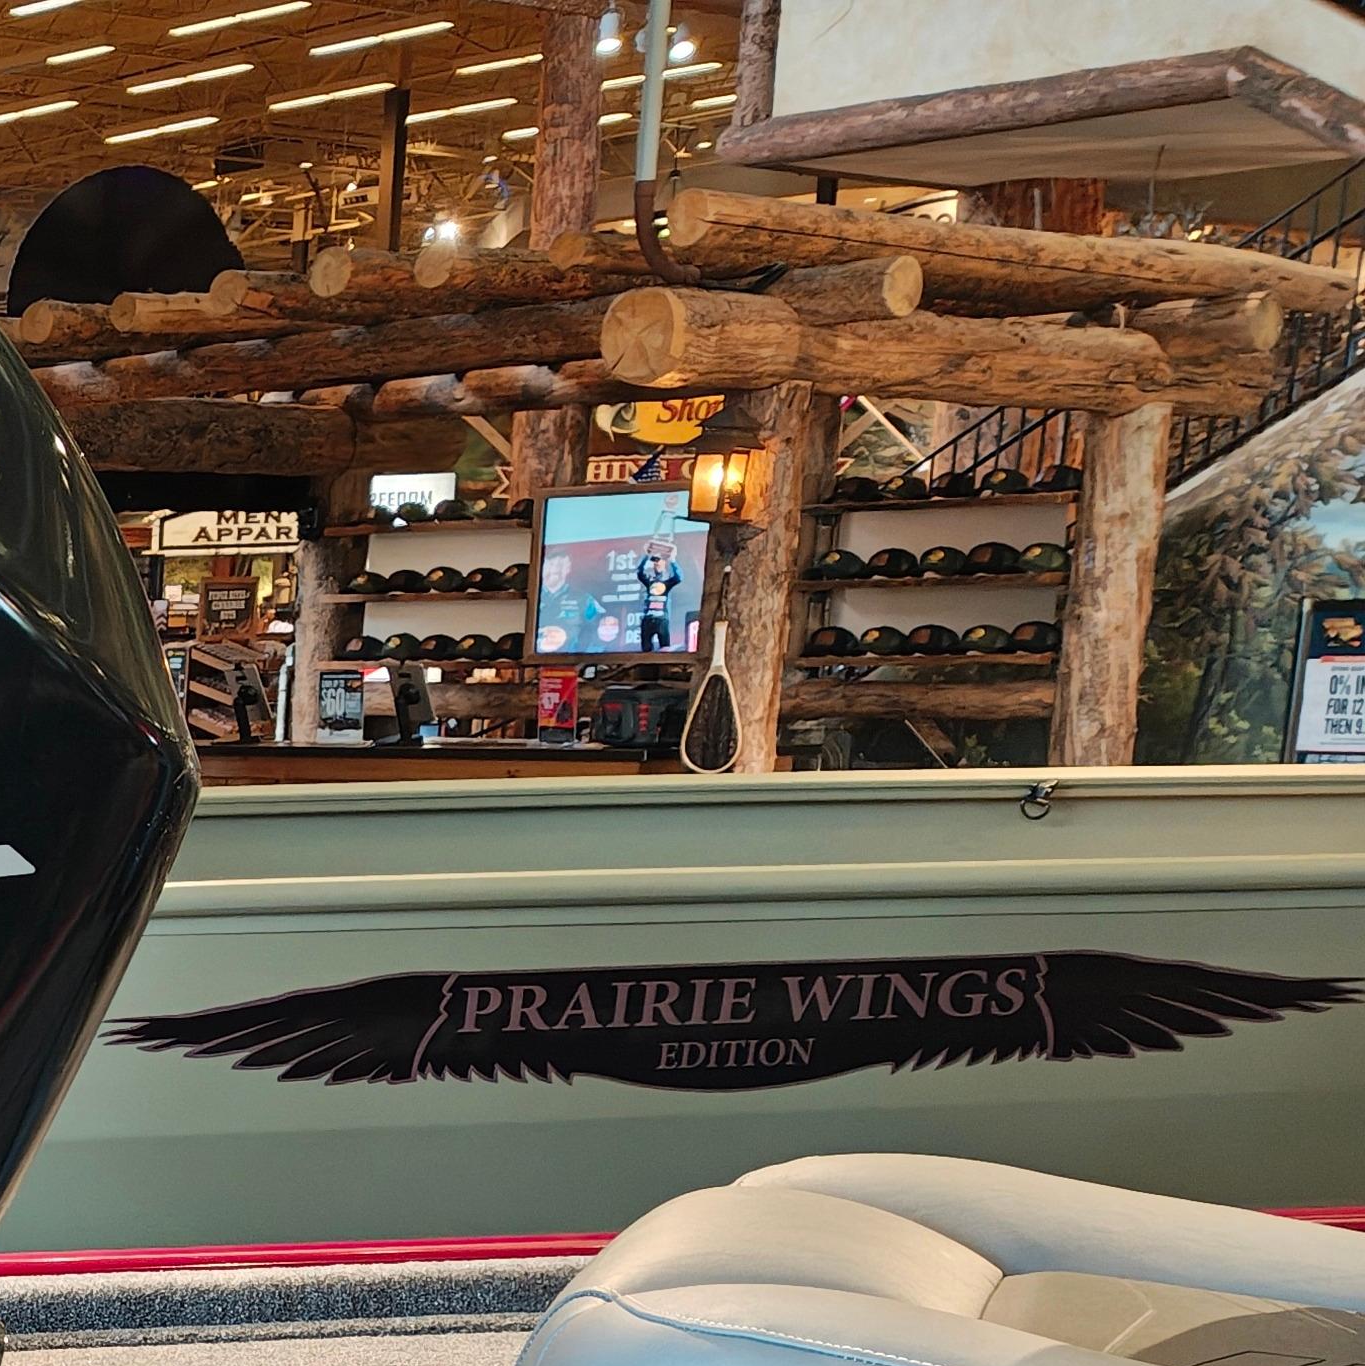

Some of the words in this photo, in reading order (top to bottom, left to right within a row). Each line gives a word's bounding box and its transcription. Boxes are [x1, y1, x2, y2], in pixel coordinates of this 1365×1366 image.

[457, 977, 758, 1033] PRAIRIE
[781, 968, 1027, 1023] WINGS
[656, 1037, 816, 1070] EDITION
